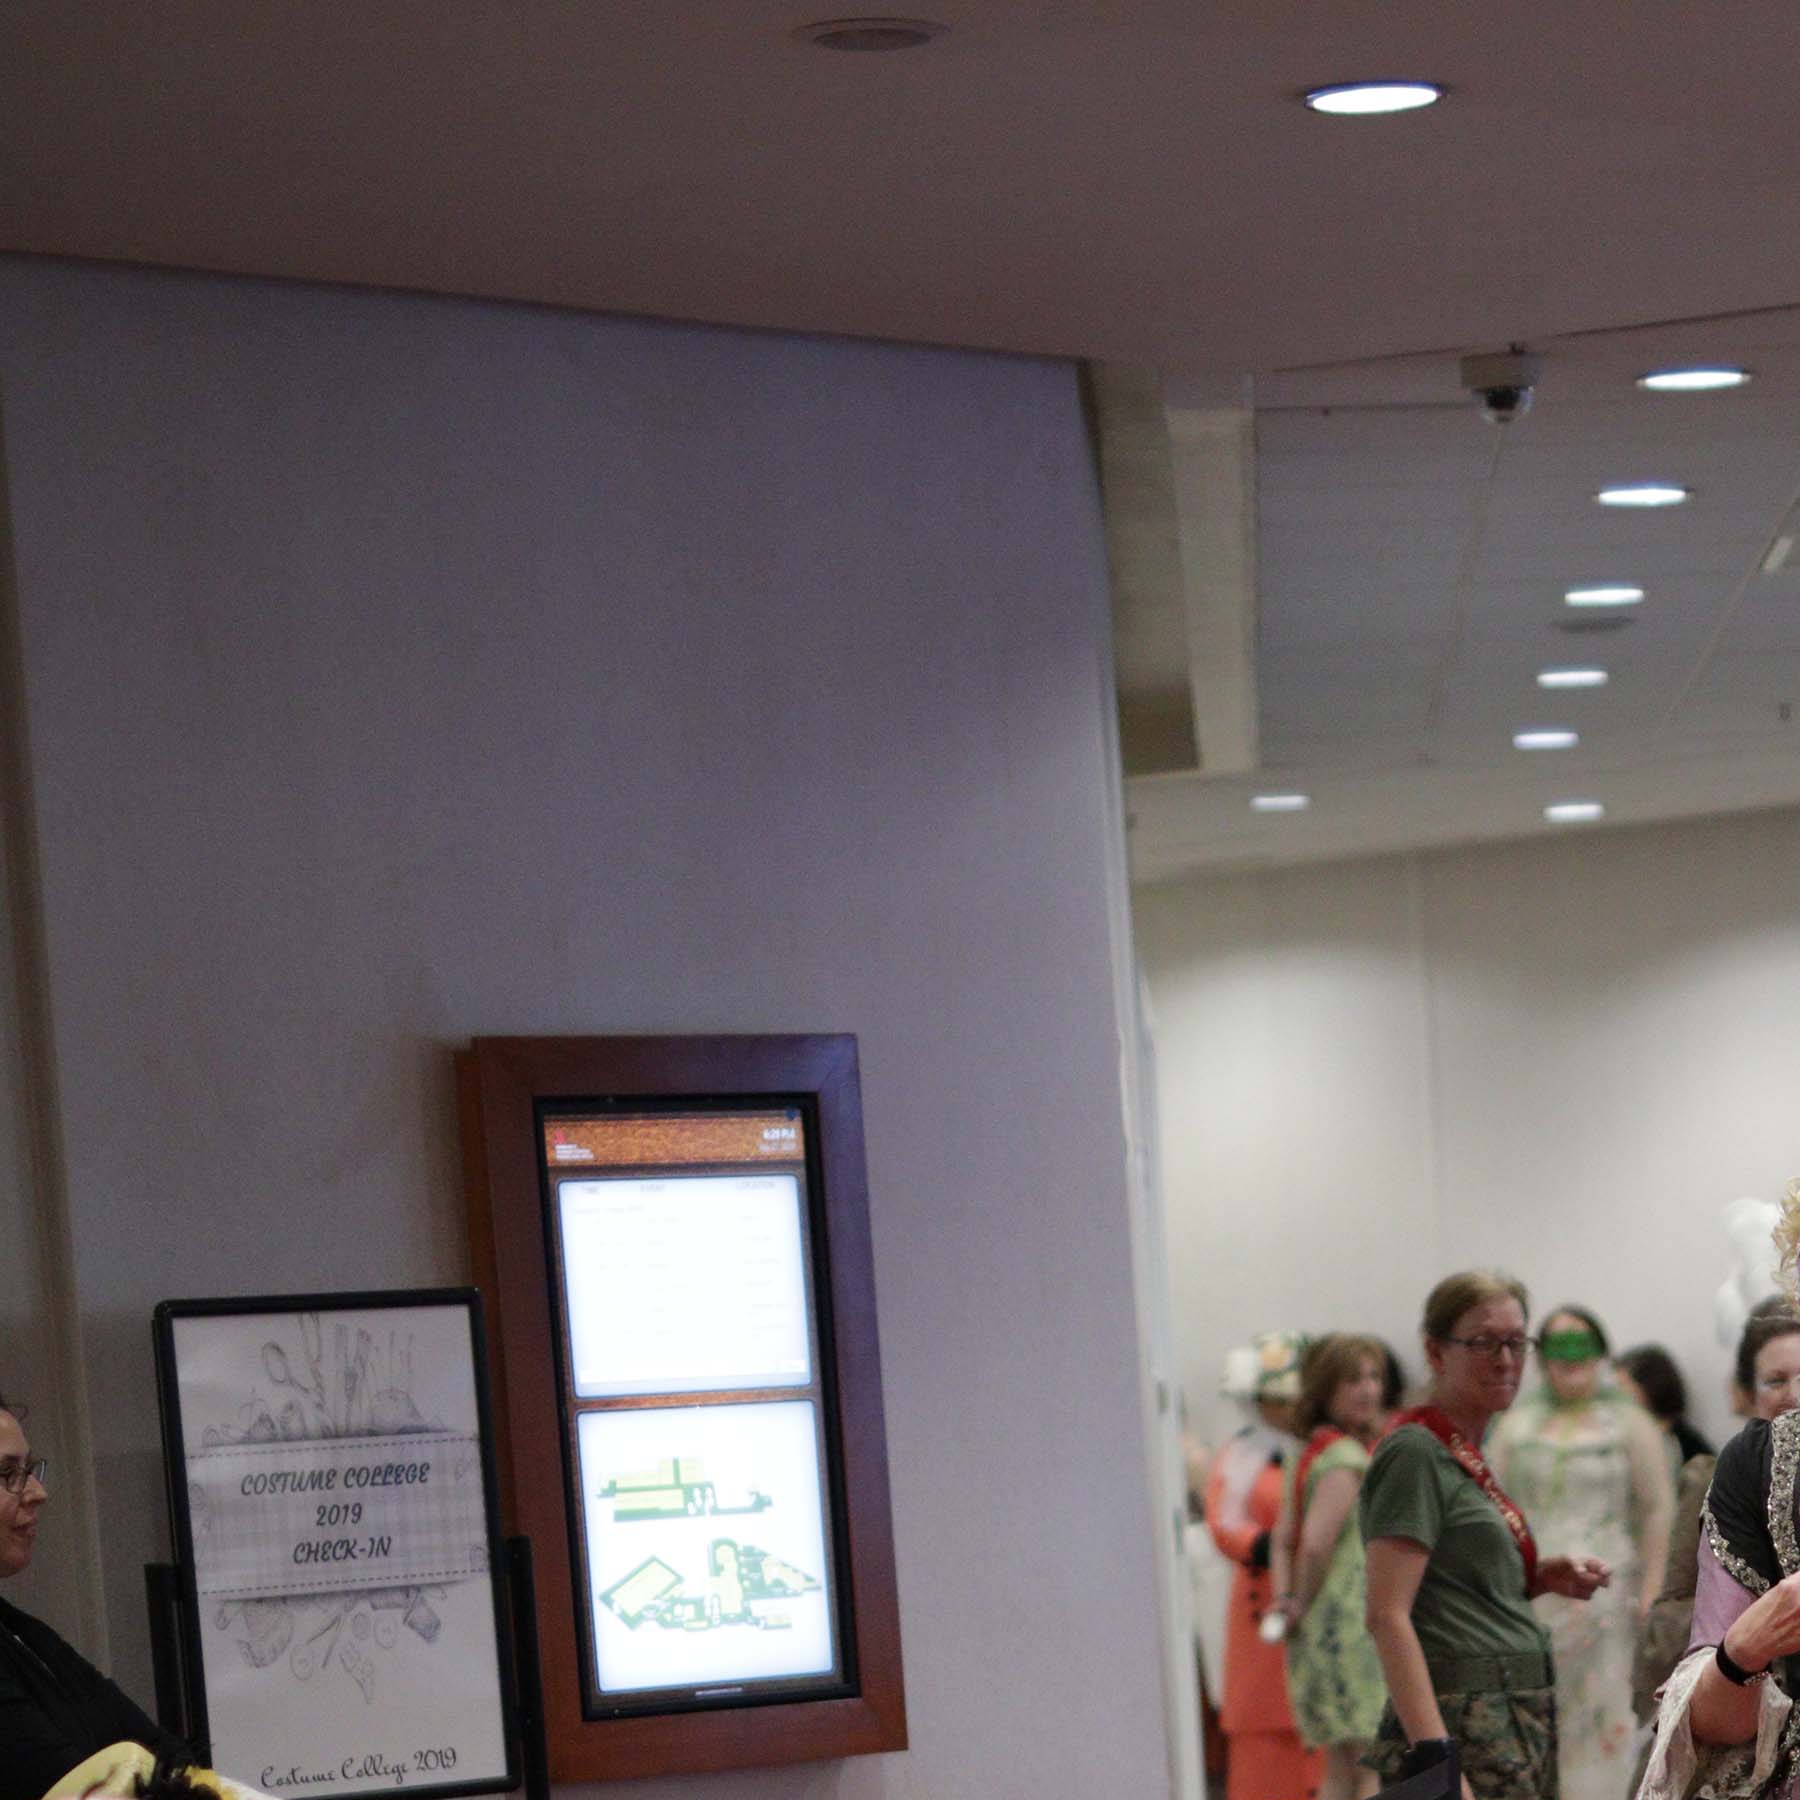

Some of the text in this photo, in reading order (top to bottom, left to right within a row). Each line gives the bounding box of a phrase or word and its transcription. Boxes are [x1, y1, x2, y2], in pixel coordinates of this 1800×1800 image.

[241, 1462, 430, 1496] COSTUME COLLEGE
[316, 1503, 362, 1527] 2019
[292, 1536, 392, 1564] CHECK-IN
[261, 1747, 457, 1789] Costume College 2019
